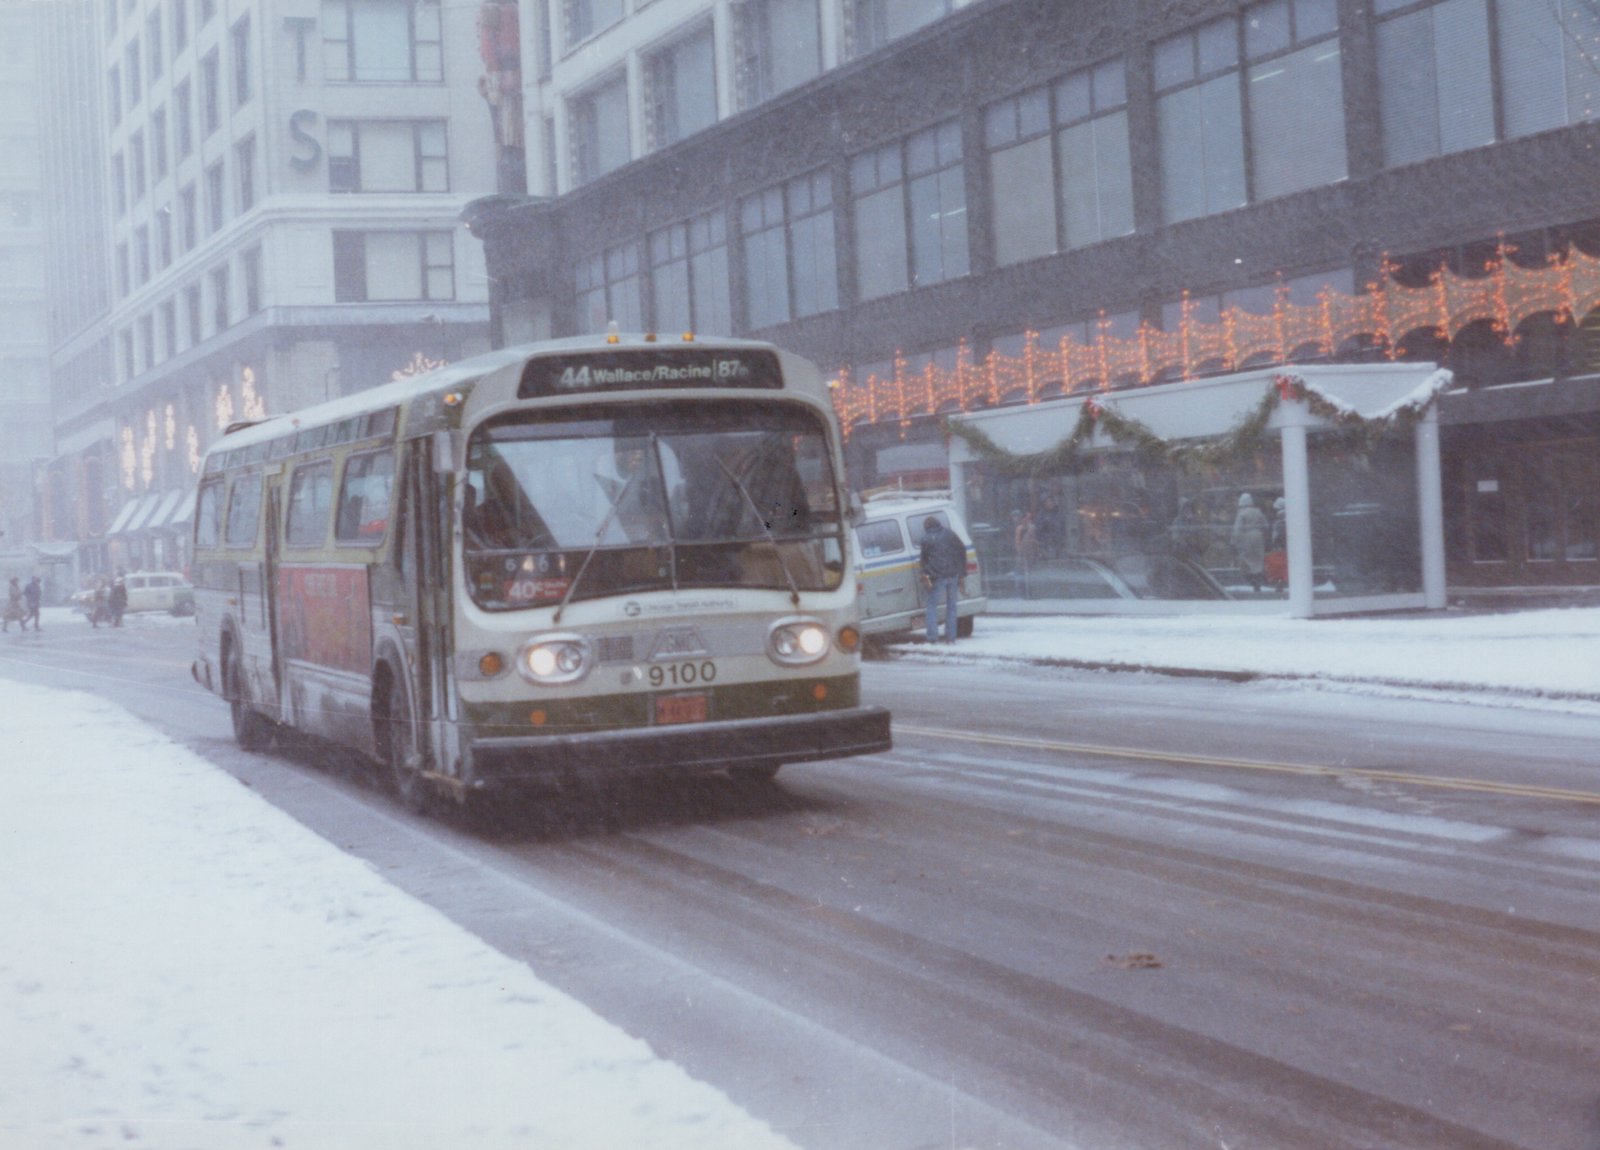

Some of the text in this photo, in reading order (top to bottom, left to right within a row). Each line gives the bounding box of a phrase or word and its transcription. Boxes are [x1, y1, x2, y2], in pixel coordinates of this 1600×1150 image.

[560, 365, 591, 387] 44
[593, 364, 712, 384] Wallace/Racine
[648, 661, 717, 687] 9100
